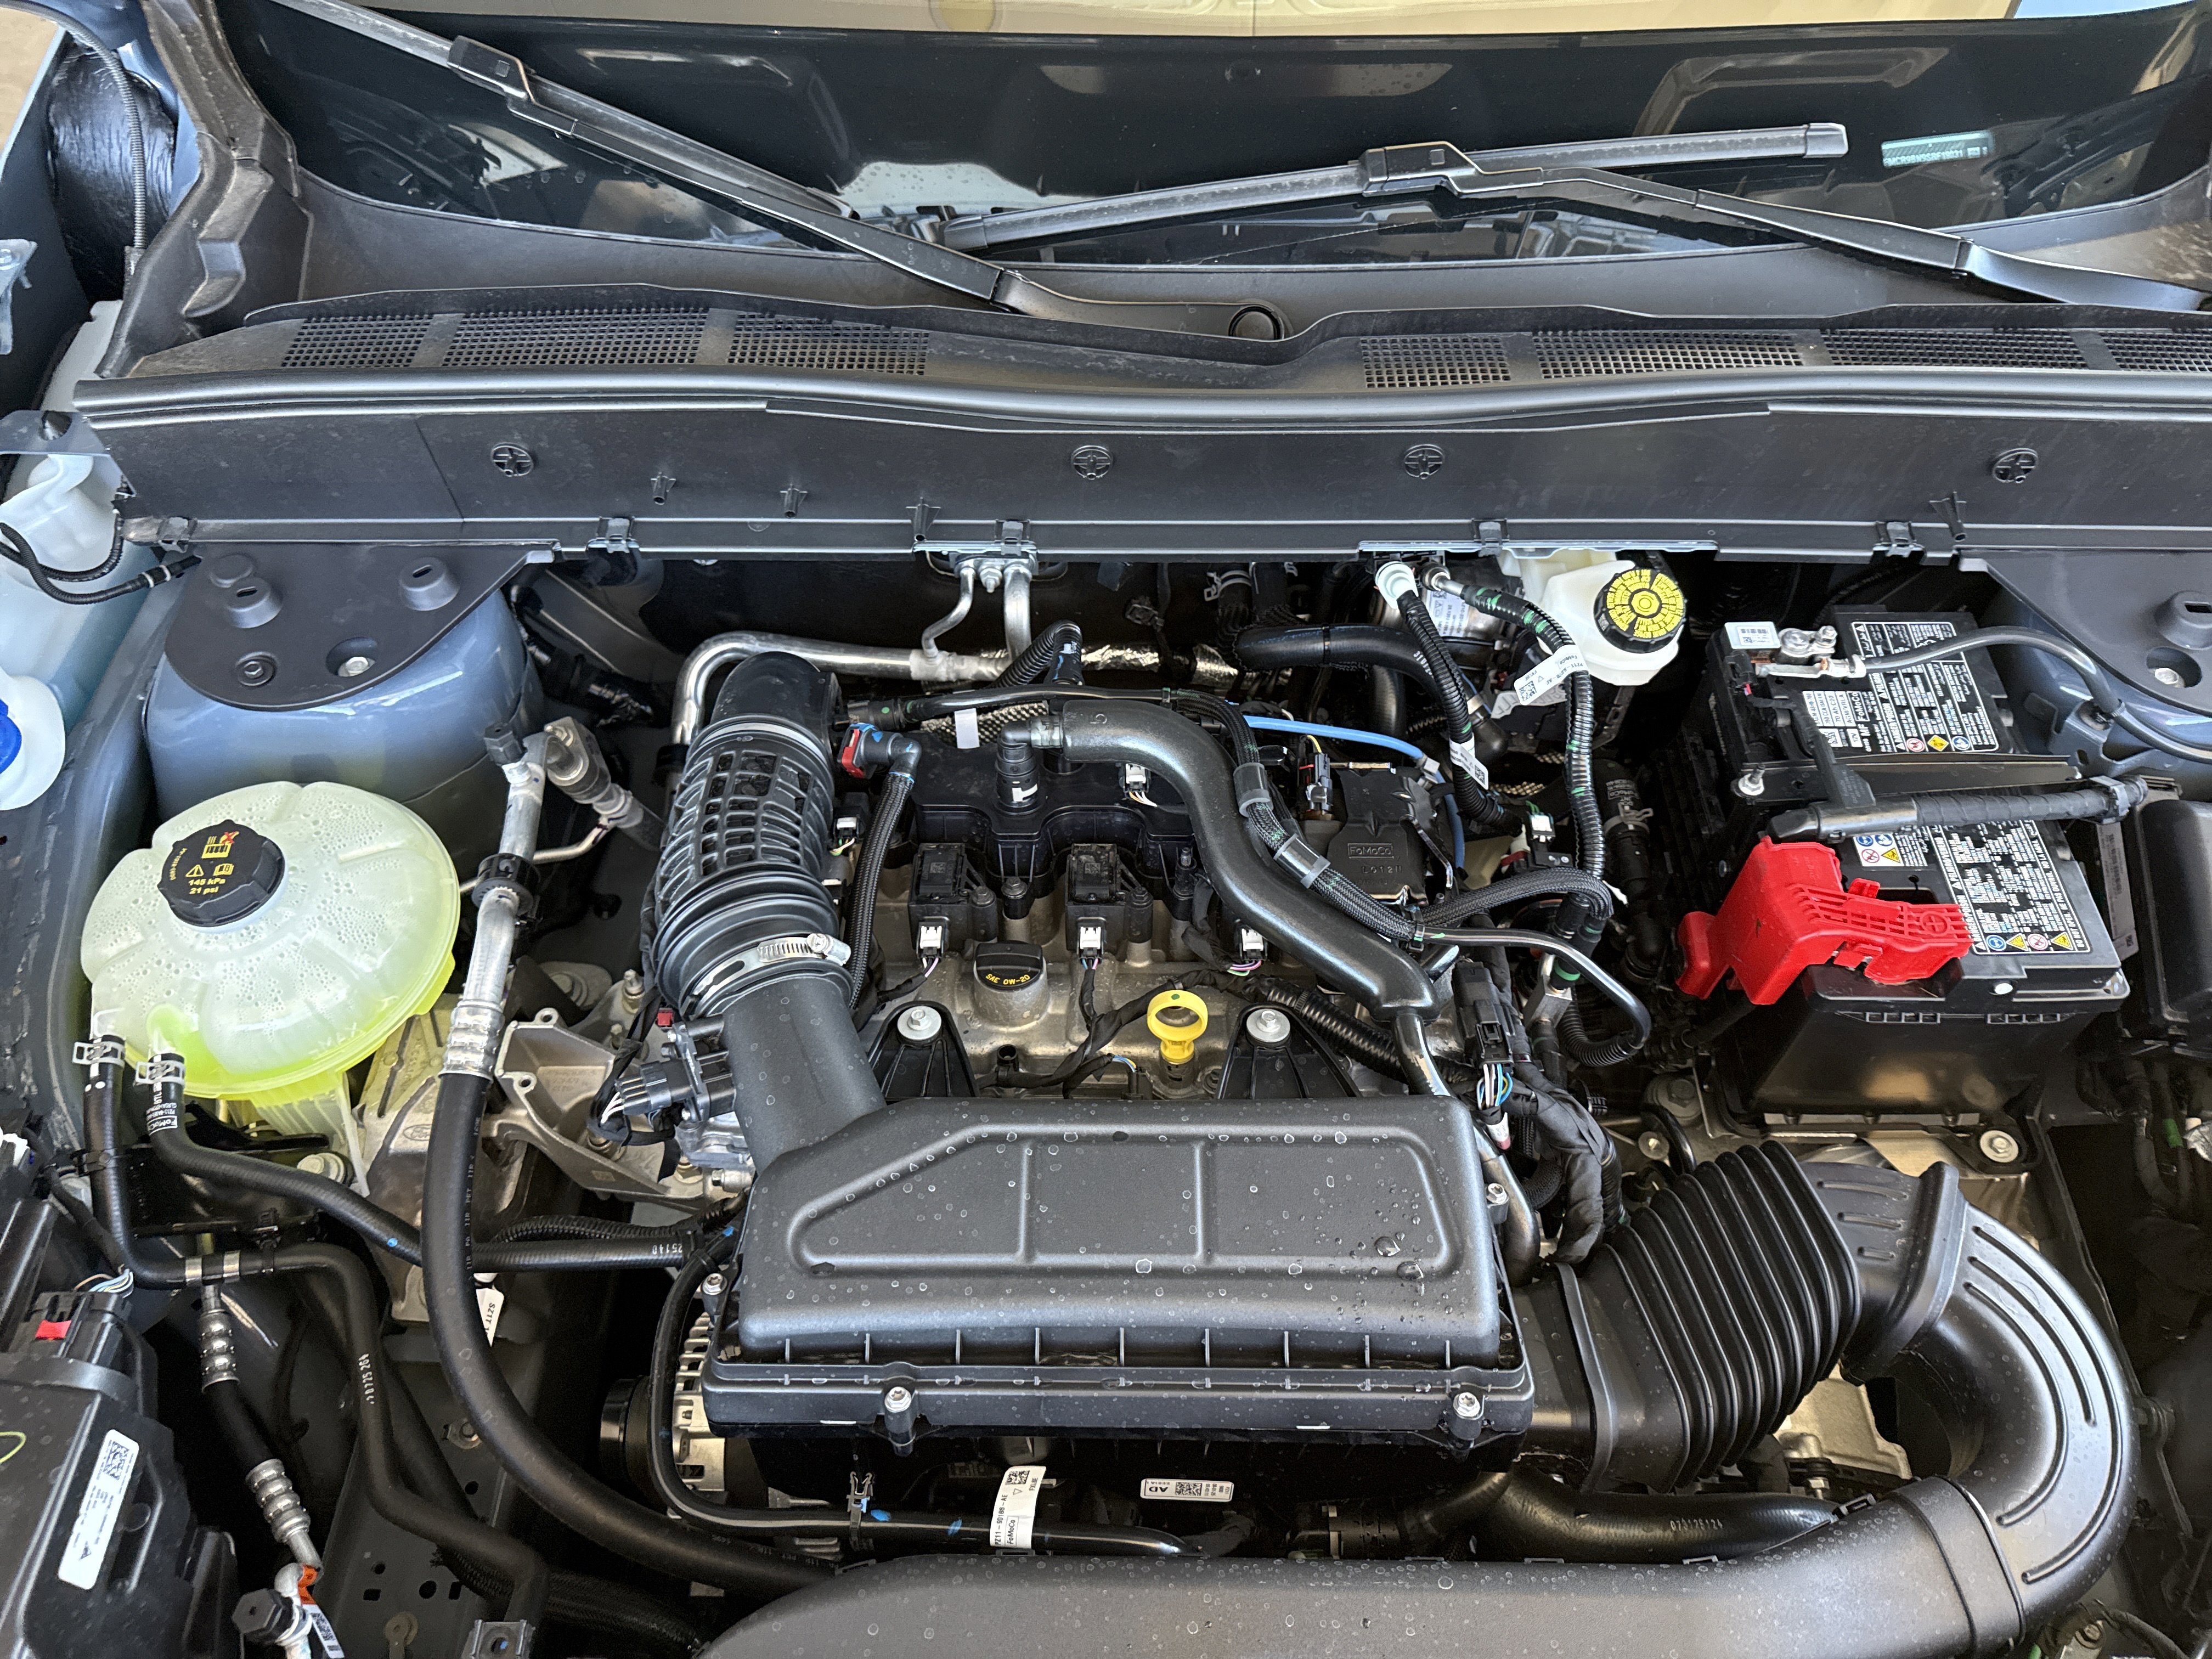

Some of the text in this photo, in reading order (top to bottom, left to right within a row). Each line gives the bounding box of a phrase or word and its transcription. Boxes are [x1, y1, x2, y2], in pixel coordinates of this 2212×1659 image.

[1838, 694, 1853, 723] AGM/VRLA
[1850, 692, 1866, 720] FoMoCo
[1882, 703, 1903, 742] DANGER/POISON
[1850, 732, 1859, 742] 12V
[1858, 724, 1871, 736] MF
[1350, 847, 1392, 855] FoMoCo
[2030, 839, 2044, 853] ABRA.
[2044, 871, 2061, 891] OUVRIR.
[202, 886, 219, 895] psi
[1933, 837, 1984, 941] DANGER/POISON PELIGRO/VENENO
[2054, 892, 2065, 902] PAS
[2062, 912, 2076, 927] OPEN.
[2069, 928, 2081, 938] NOT
[985, 973, 1001, 984] SAE
[1007, 1520, 1015, 1544] FoMoCo
